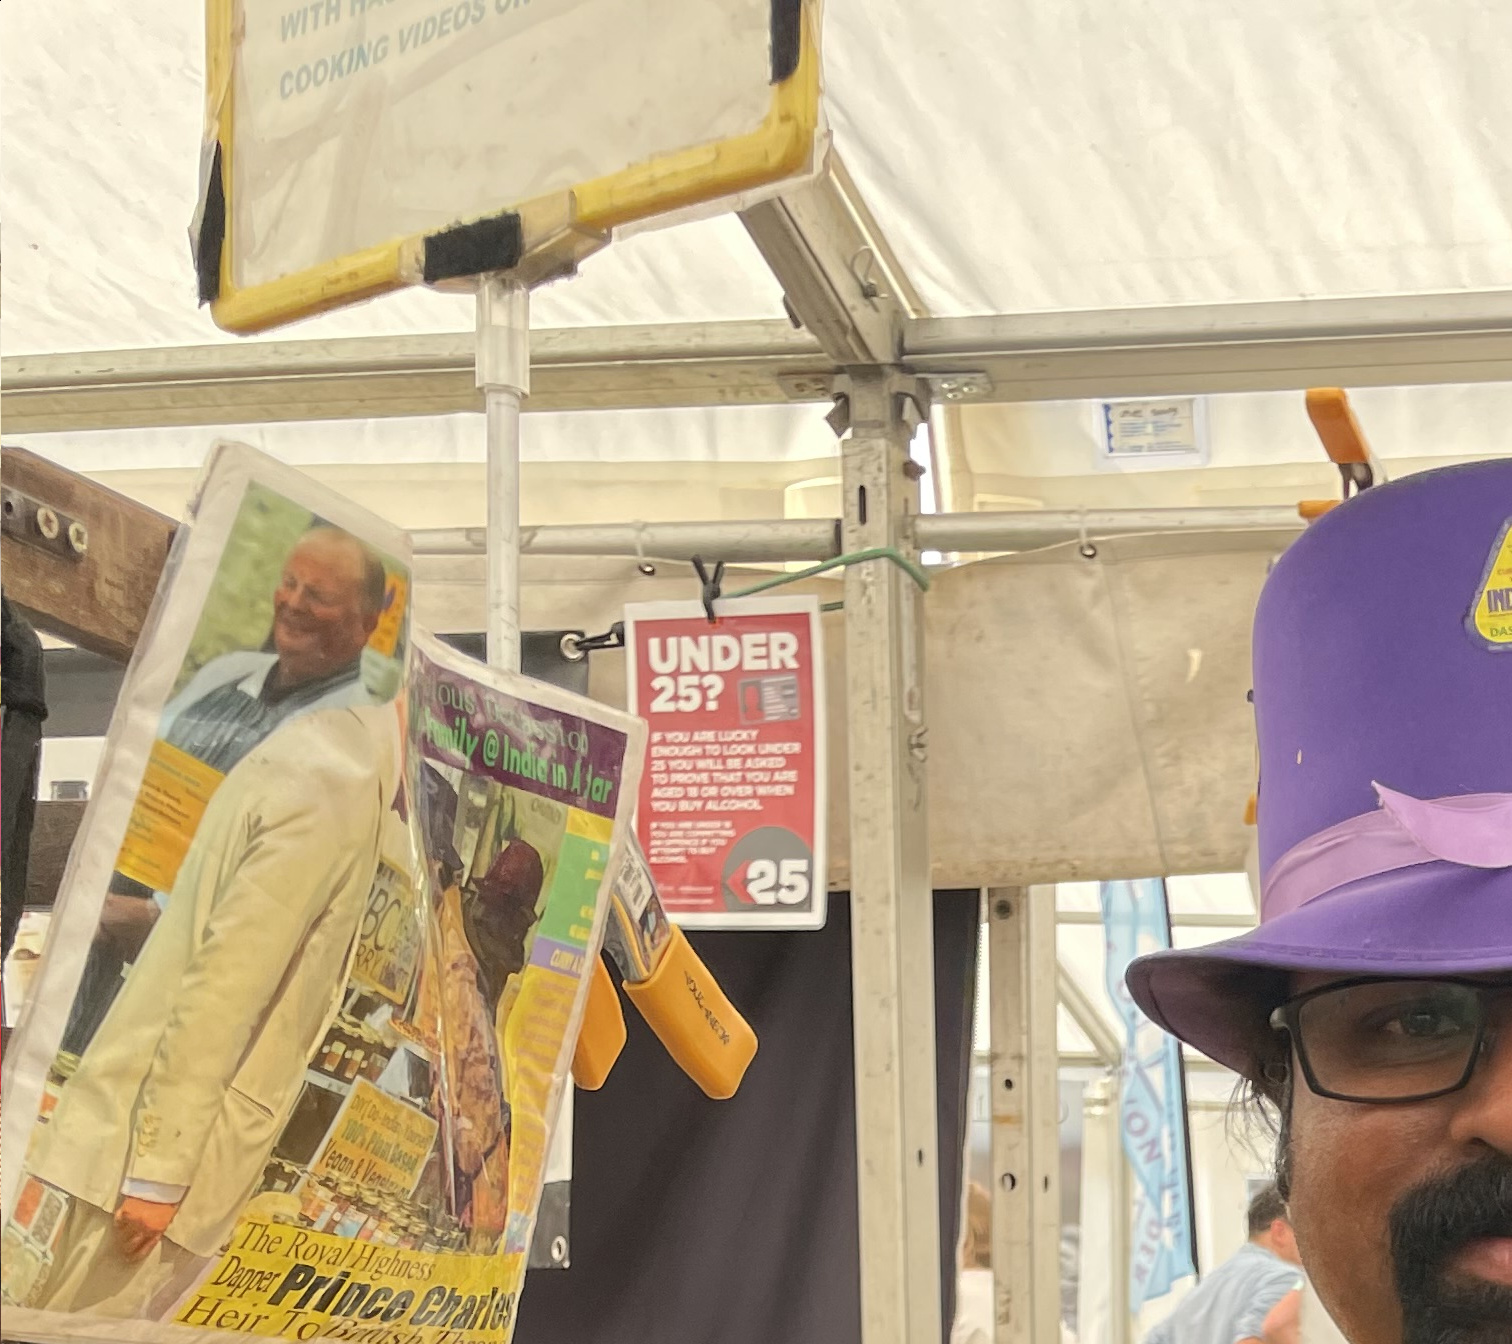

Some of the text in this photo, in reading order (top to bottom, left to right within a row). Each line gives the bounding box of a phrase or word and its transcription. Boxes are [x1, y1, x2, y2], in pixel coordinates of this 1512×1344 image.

[280, 0, 487, 100] COOKING VIDEOS
[648, 632, 800, 674] UNDER
[650, 675, 725, 713] 25?
[503, 734, 549, 783] India
[746, 859, 810, 905] 25
[238, 1222, 437, 1281] The Royal Highness
[177, 1294, 270, 1334] Heir
[279, 1311, 321, 1342] To
[212, 1256, 516, 1332] Dapper Prince Charles
